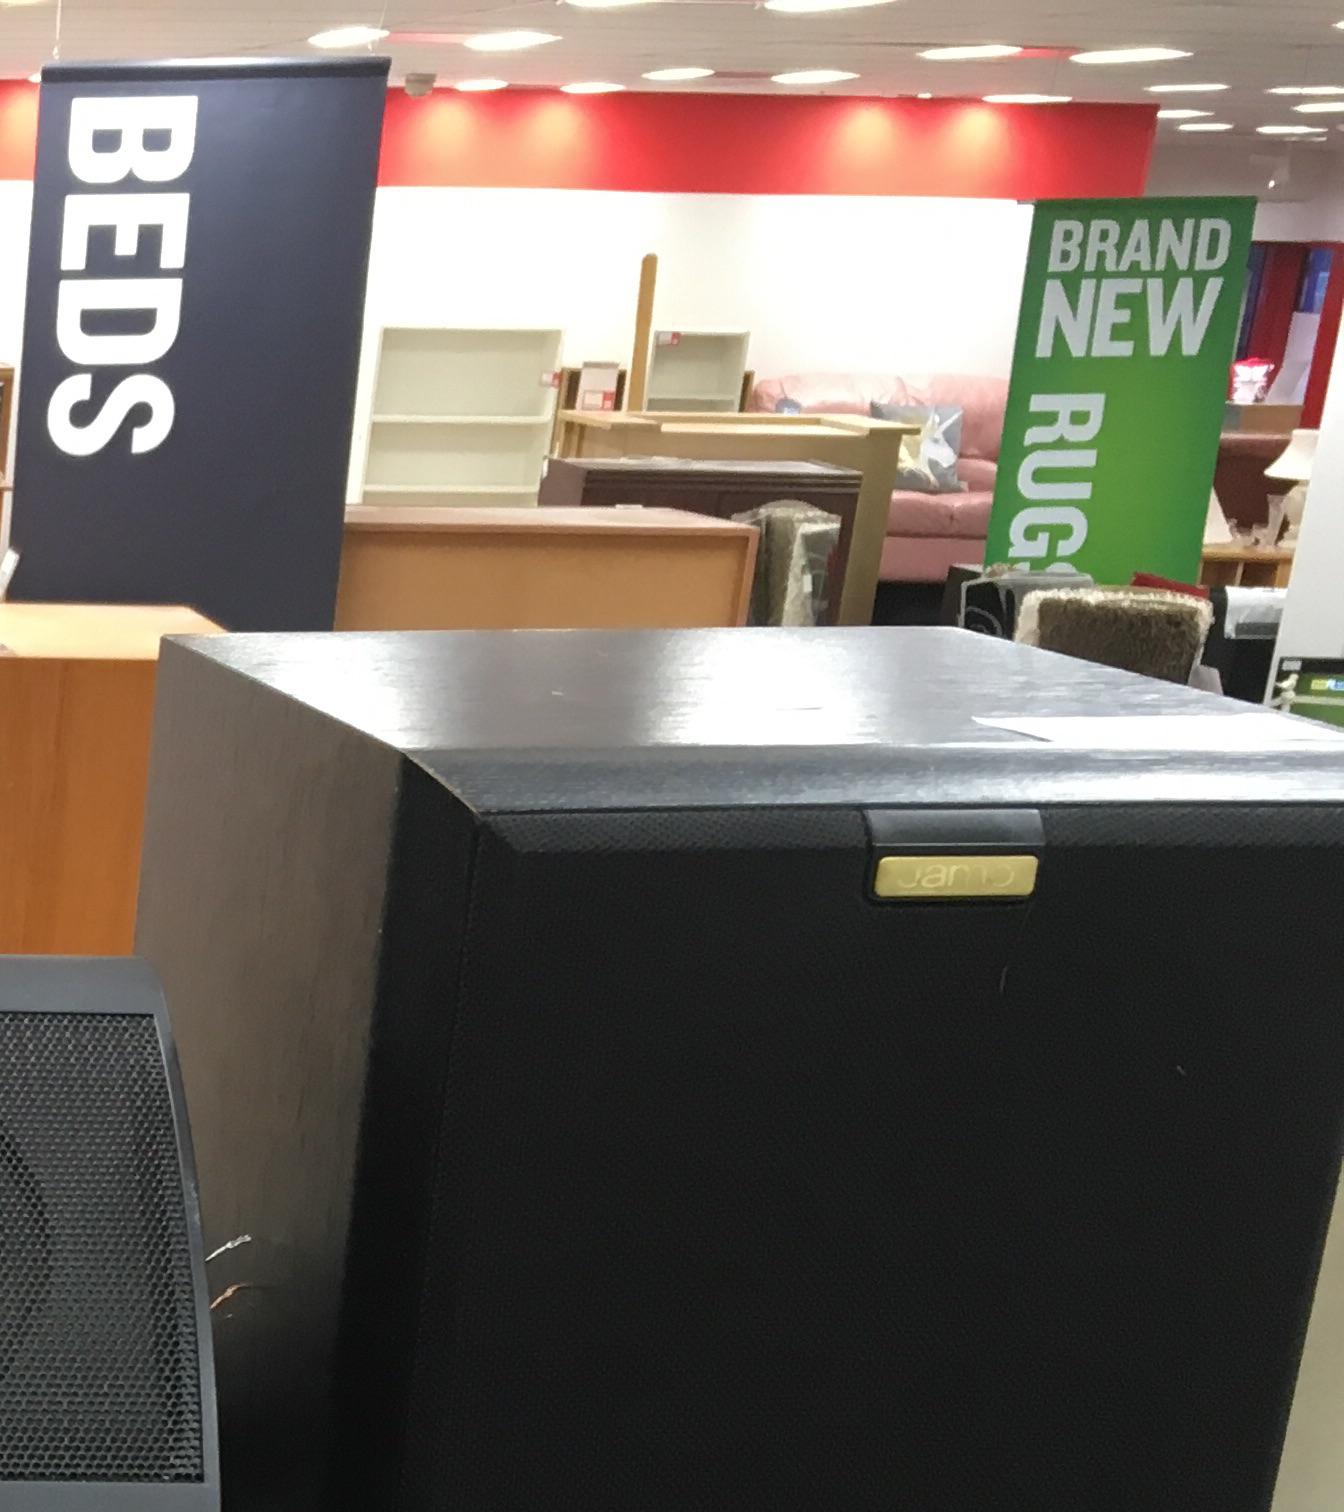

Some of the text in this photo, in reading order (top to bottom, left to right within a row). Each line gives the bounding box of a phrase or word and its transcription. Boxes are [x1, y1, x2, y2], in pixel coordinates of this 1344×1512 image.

[46, 95, 198, 457] BEDS
[1047, 218, 1233, 273] BRAND
[1035, 277, 1224, 358] NEW
[1008, 393, 1106, 574] RUG
